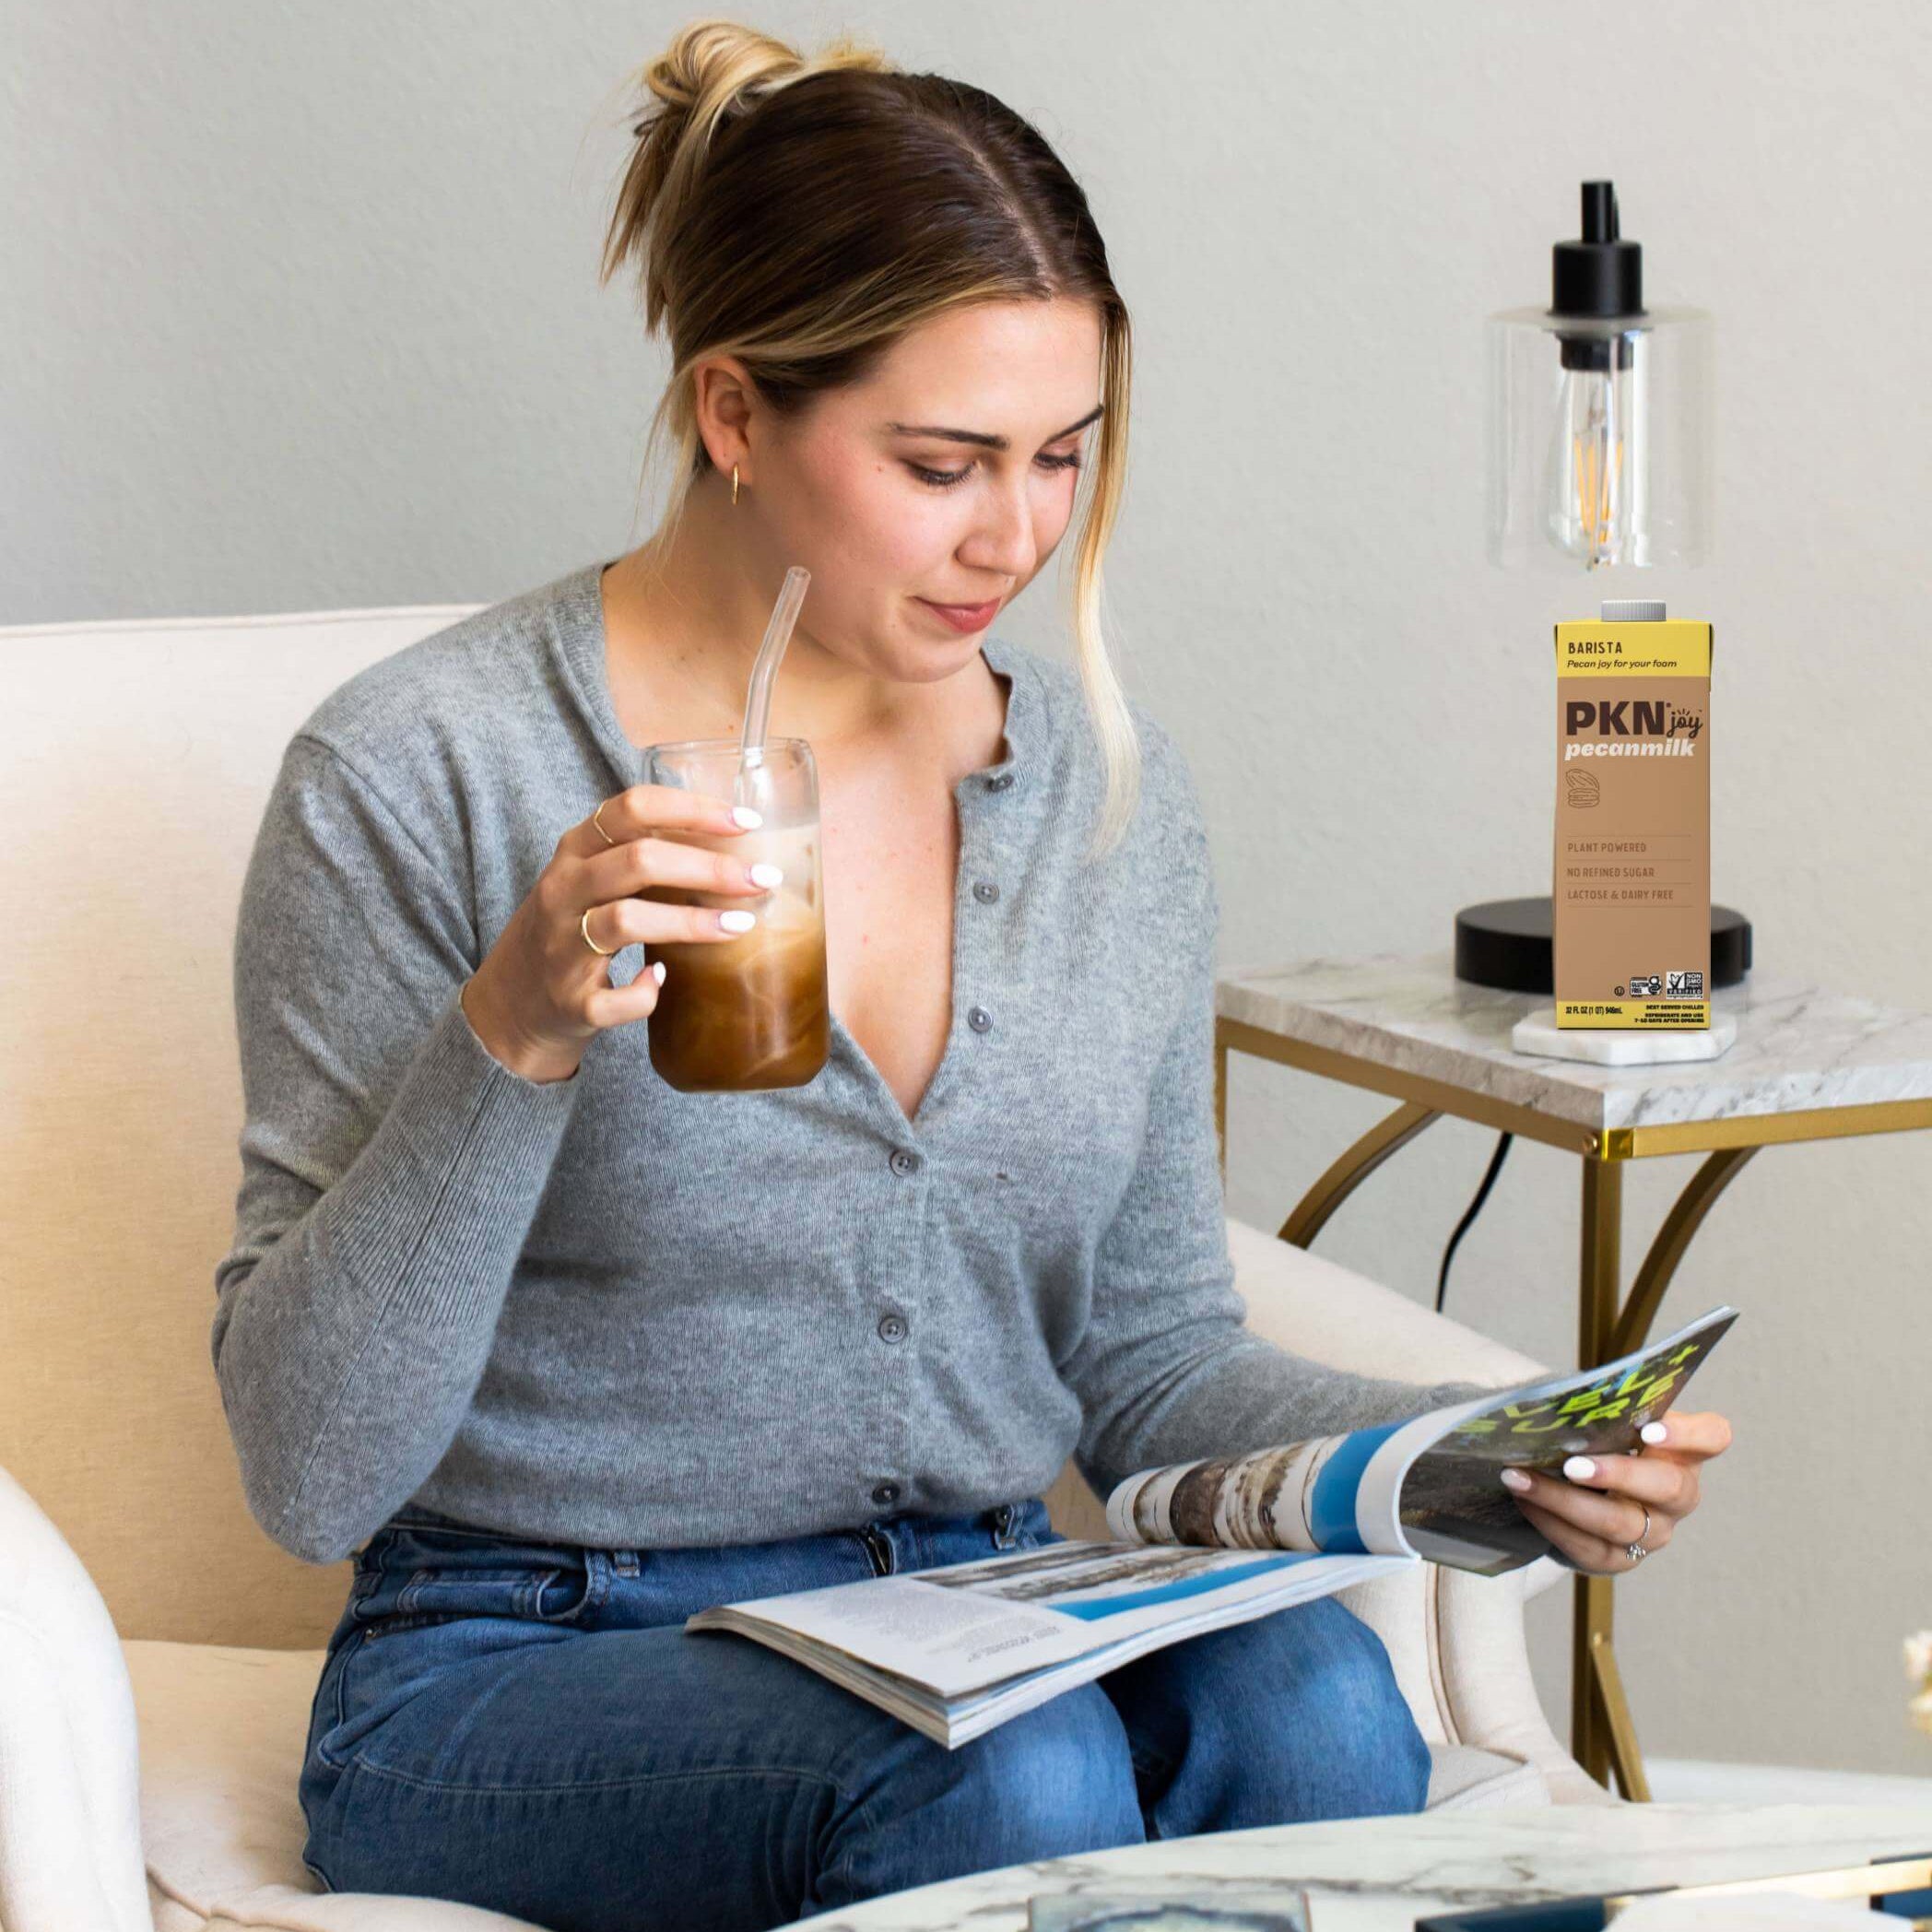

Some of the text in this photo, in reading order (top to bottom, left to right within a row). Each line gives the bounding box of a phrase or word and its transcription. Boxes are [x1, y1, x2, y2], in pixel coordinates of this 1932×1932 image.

[1568, 642, 1623, 654] BARISTA
[1567, 660, 1596, 668] Pecan
[1597, 660, 1611, 670] joy
[1613, 660, 1628, 668] for
[1653, 659, 1678, 668] foam
[1566, 701, 1703, 739] PKN joy
[1564, 738, 1696, 761] pecanmilk
[1568, 842, 1647, 853] PLANT POWERED
[1567, 867, 1655, 878] NO REFINED SUGAR
[1568, 889, 1674, 900] LACTOSE & DAIRY FREE
